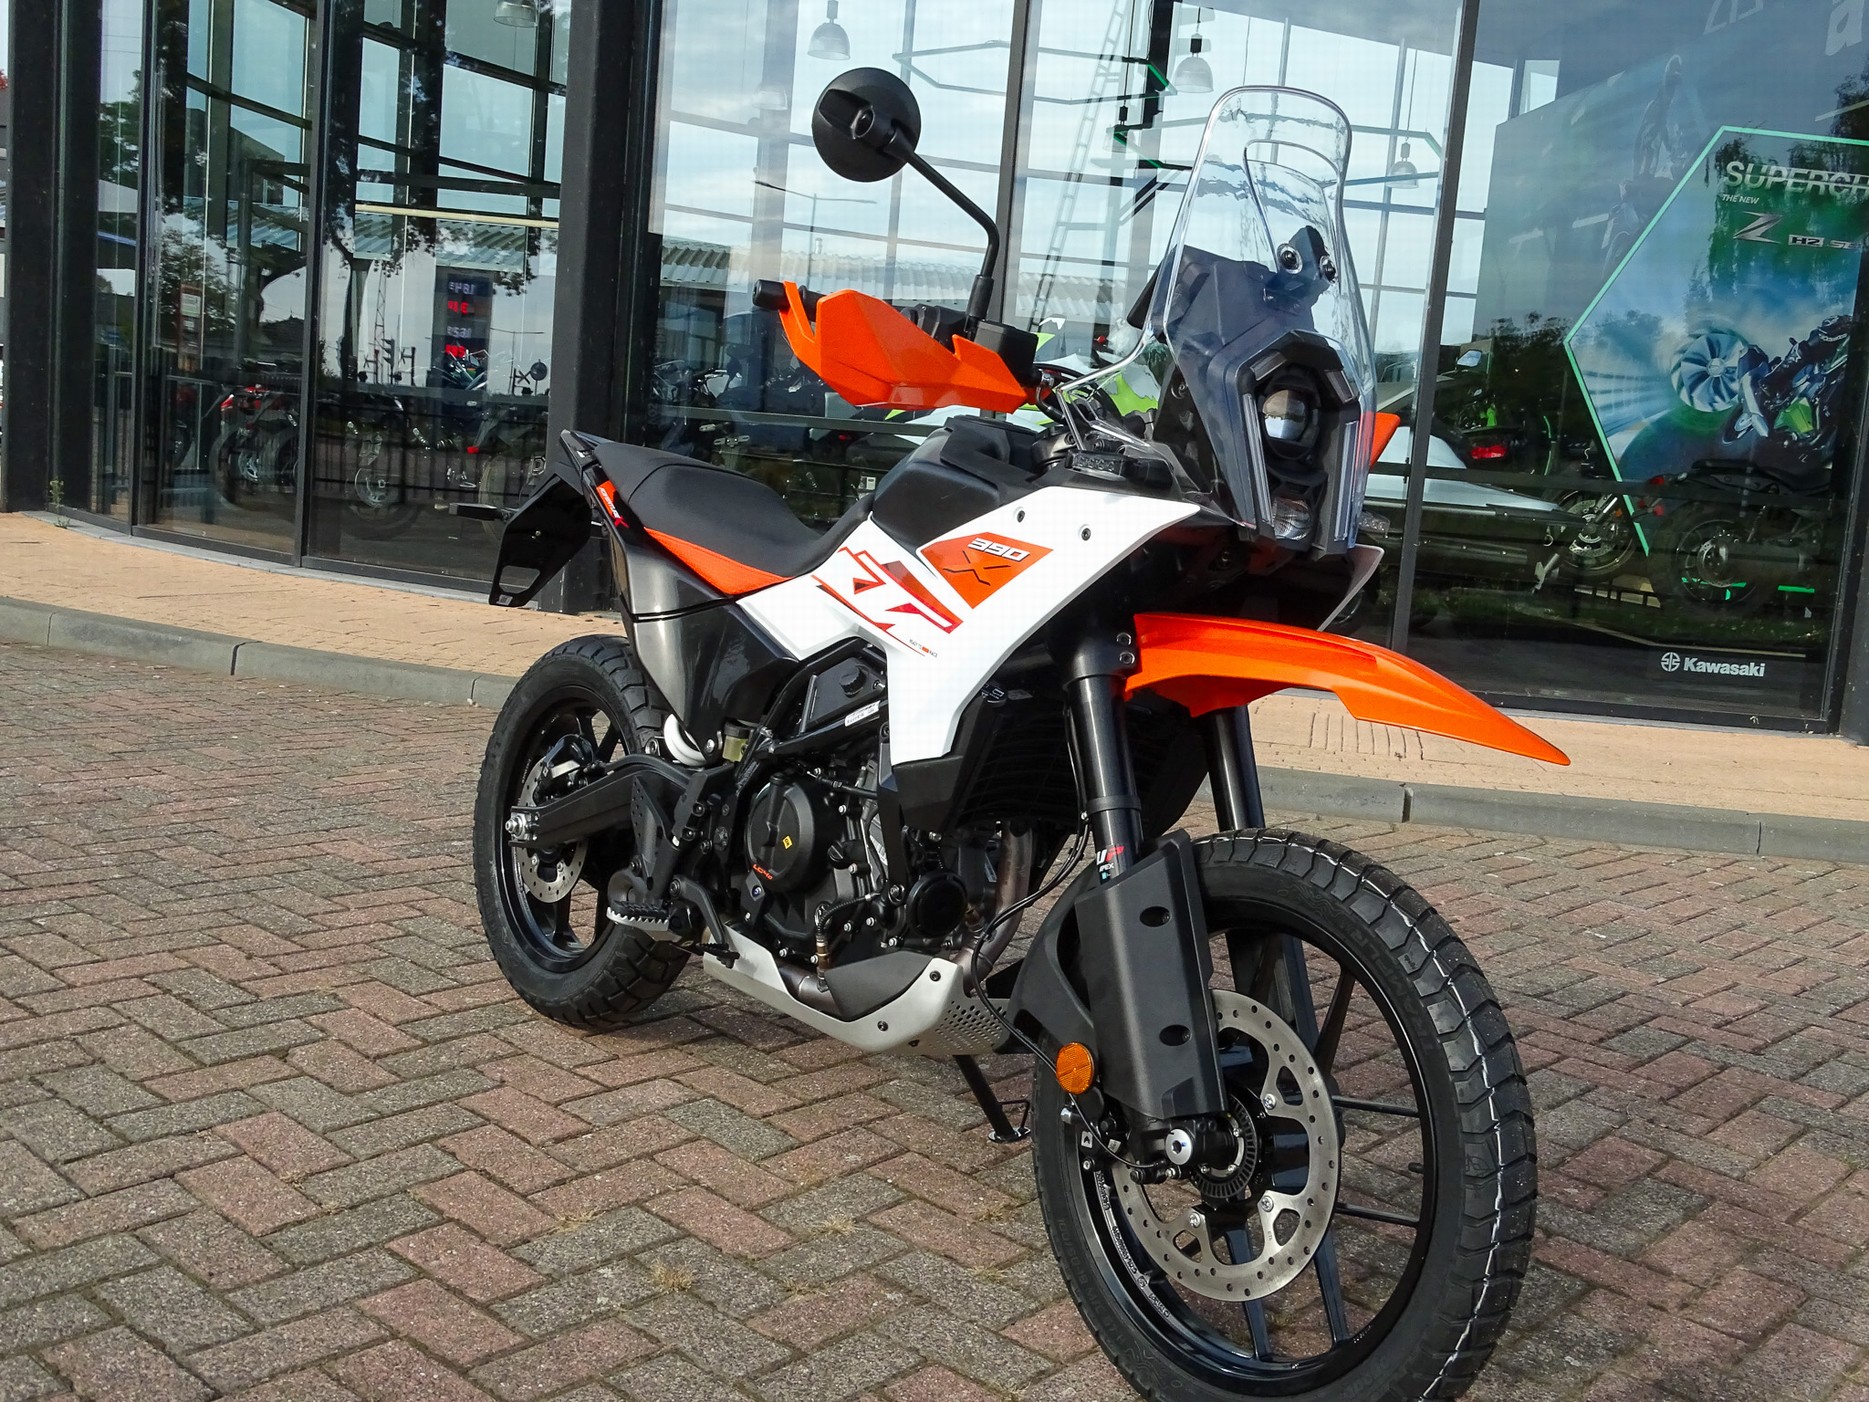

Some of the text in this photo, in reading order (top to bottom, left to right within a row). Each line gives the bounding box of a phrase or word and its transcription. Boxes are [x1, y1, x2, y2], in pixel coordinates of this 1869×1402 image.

[1722, 193, 1760, 205] THE NEW
[1790, 236, 1821, 246] H2
[967, 537, 1031, 562] 390
[1683, 656, 1766, 677] Kawasaki
